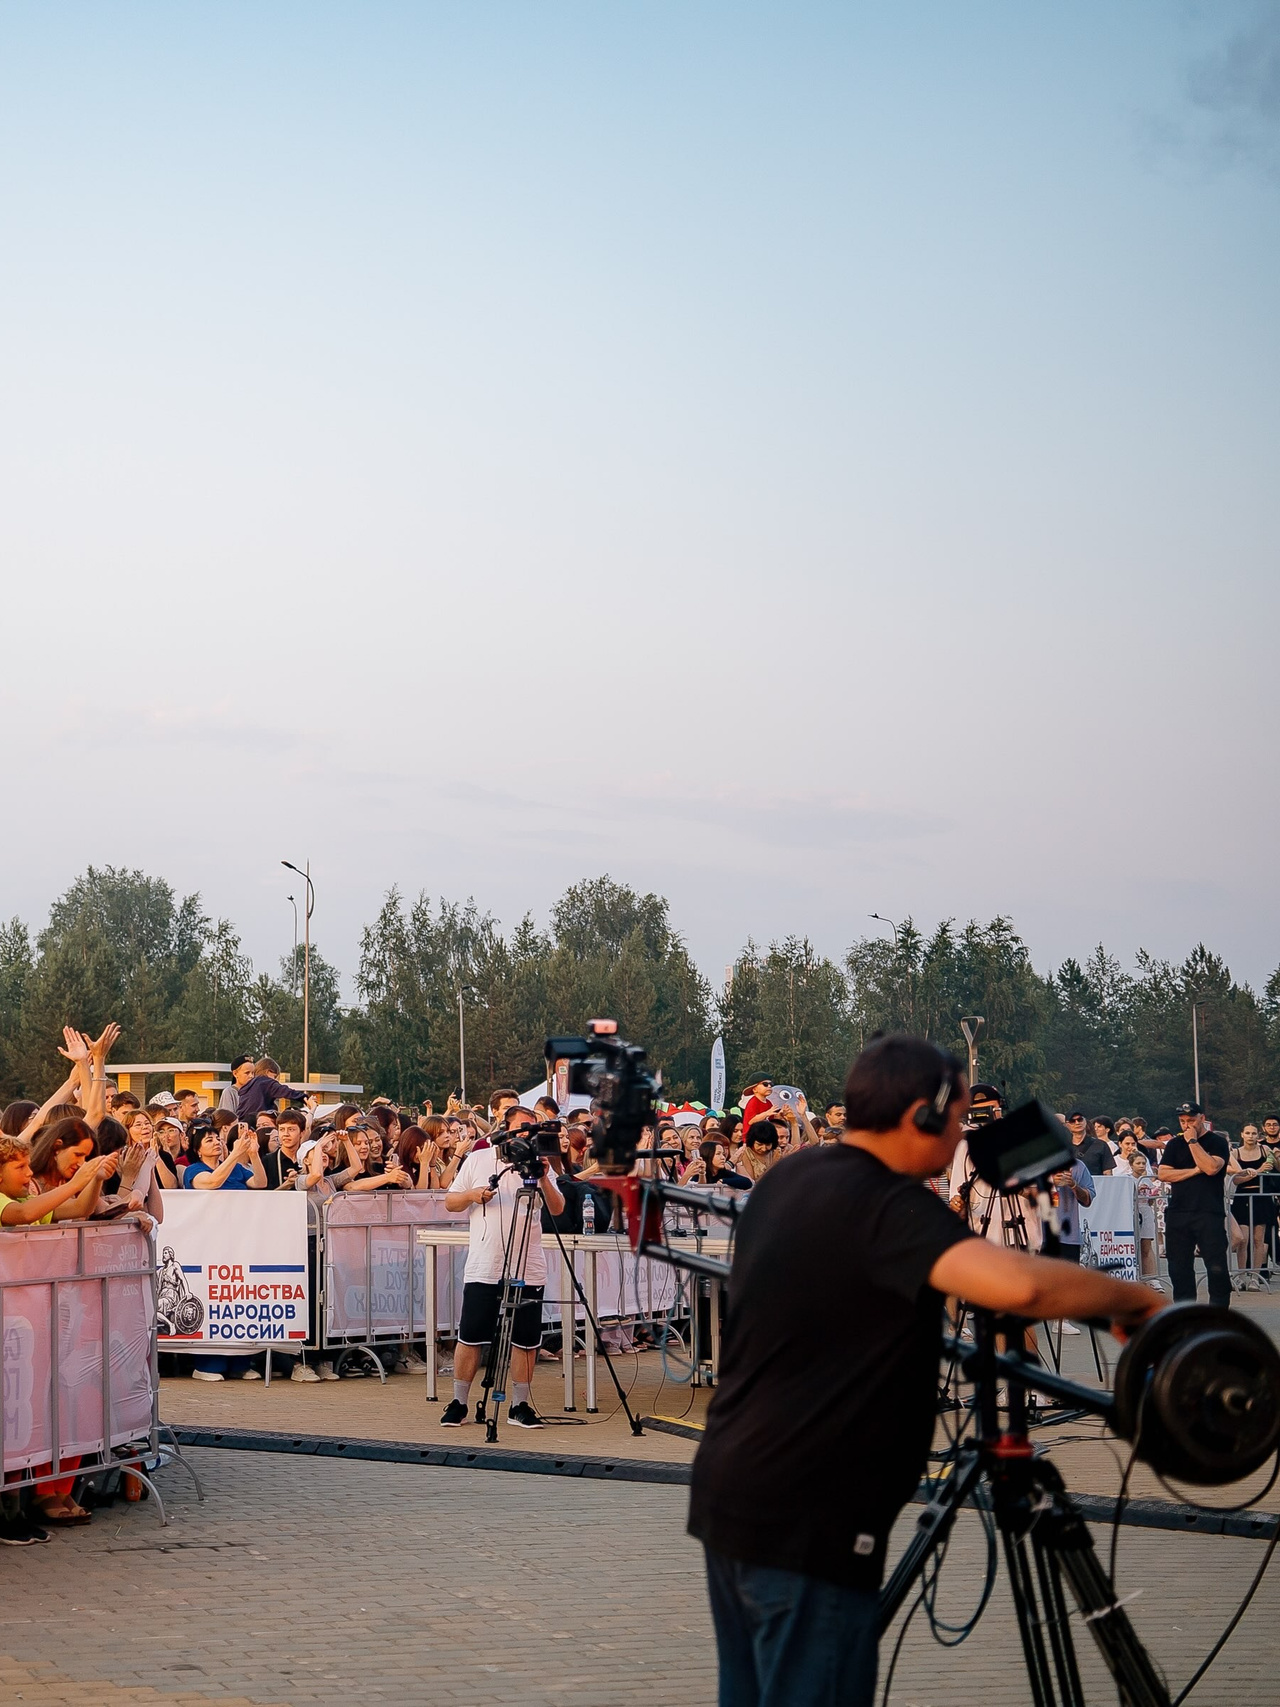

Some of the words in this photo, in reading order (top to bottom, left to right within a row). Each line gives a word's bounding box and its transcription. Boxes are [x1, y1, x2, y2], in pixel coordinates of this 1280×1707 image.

[1100, 1231, 1112, 1242] ГОД
[1101, 1244, 1135, 1256] ЕДИНСТВ
[208, 1265, 244, 1282] ГОД
[208, 1285, 305, 1302] ЕДИНСТВА
[209, 1304, 296, 1322] НАРОДОВ
[209, 1324, 285, 1339] РОССИИ
